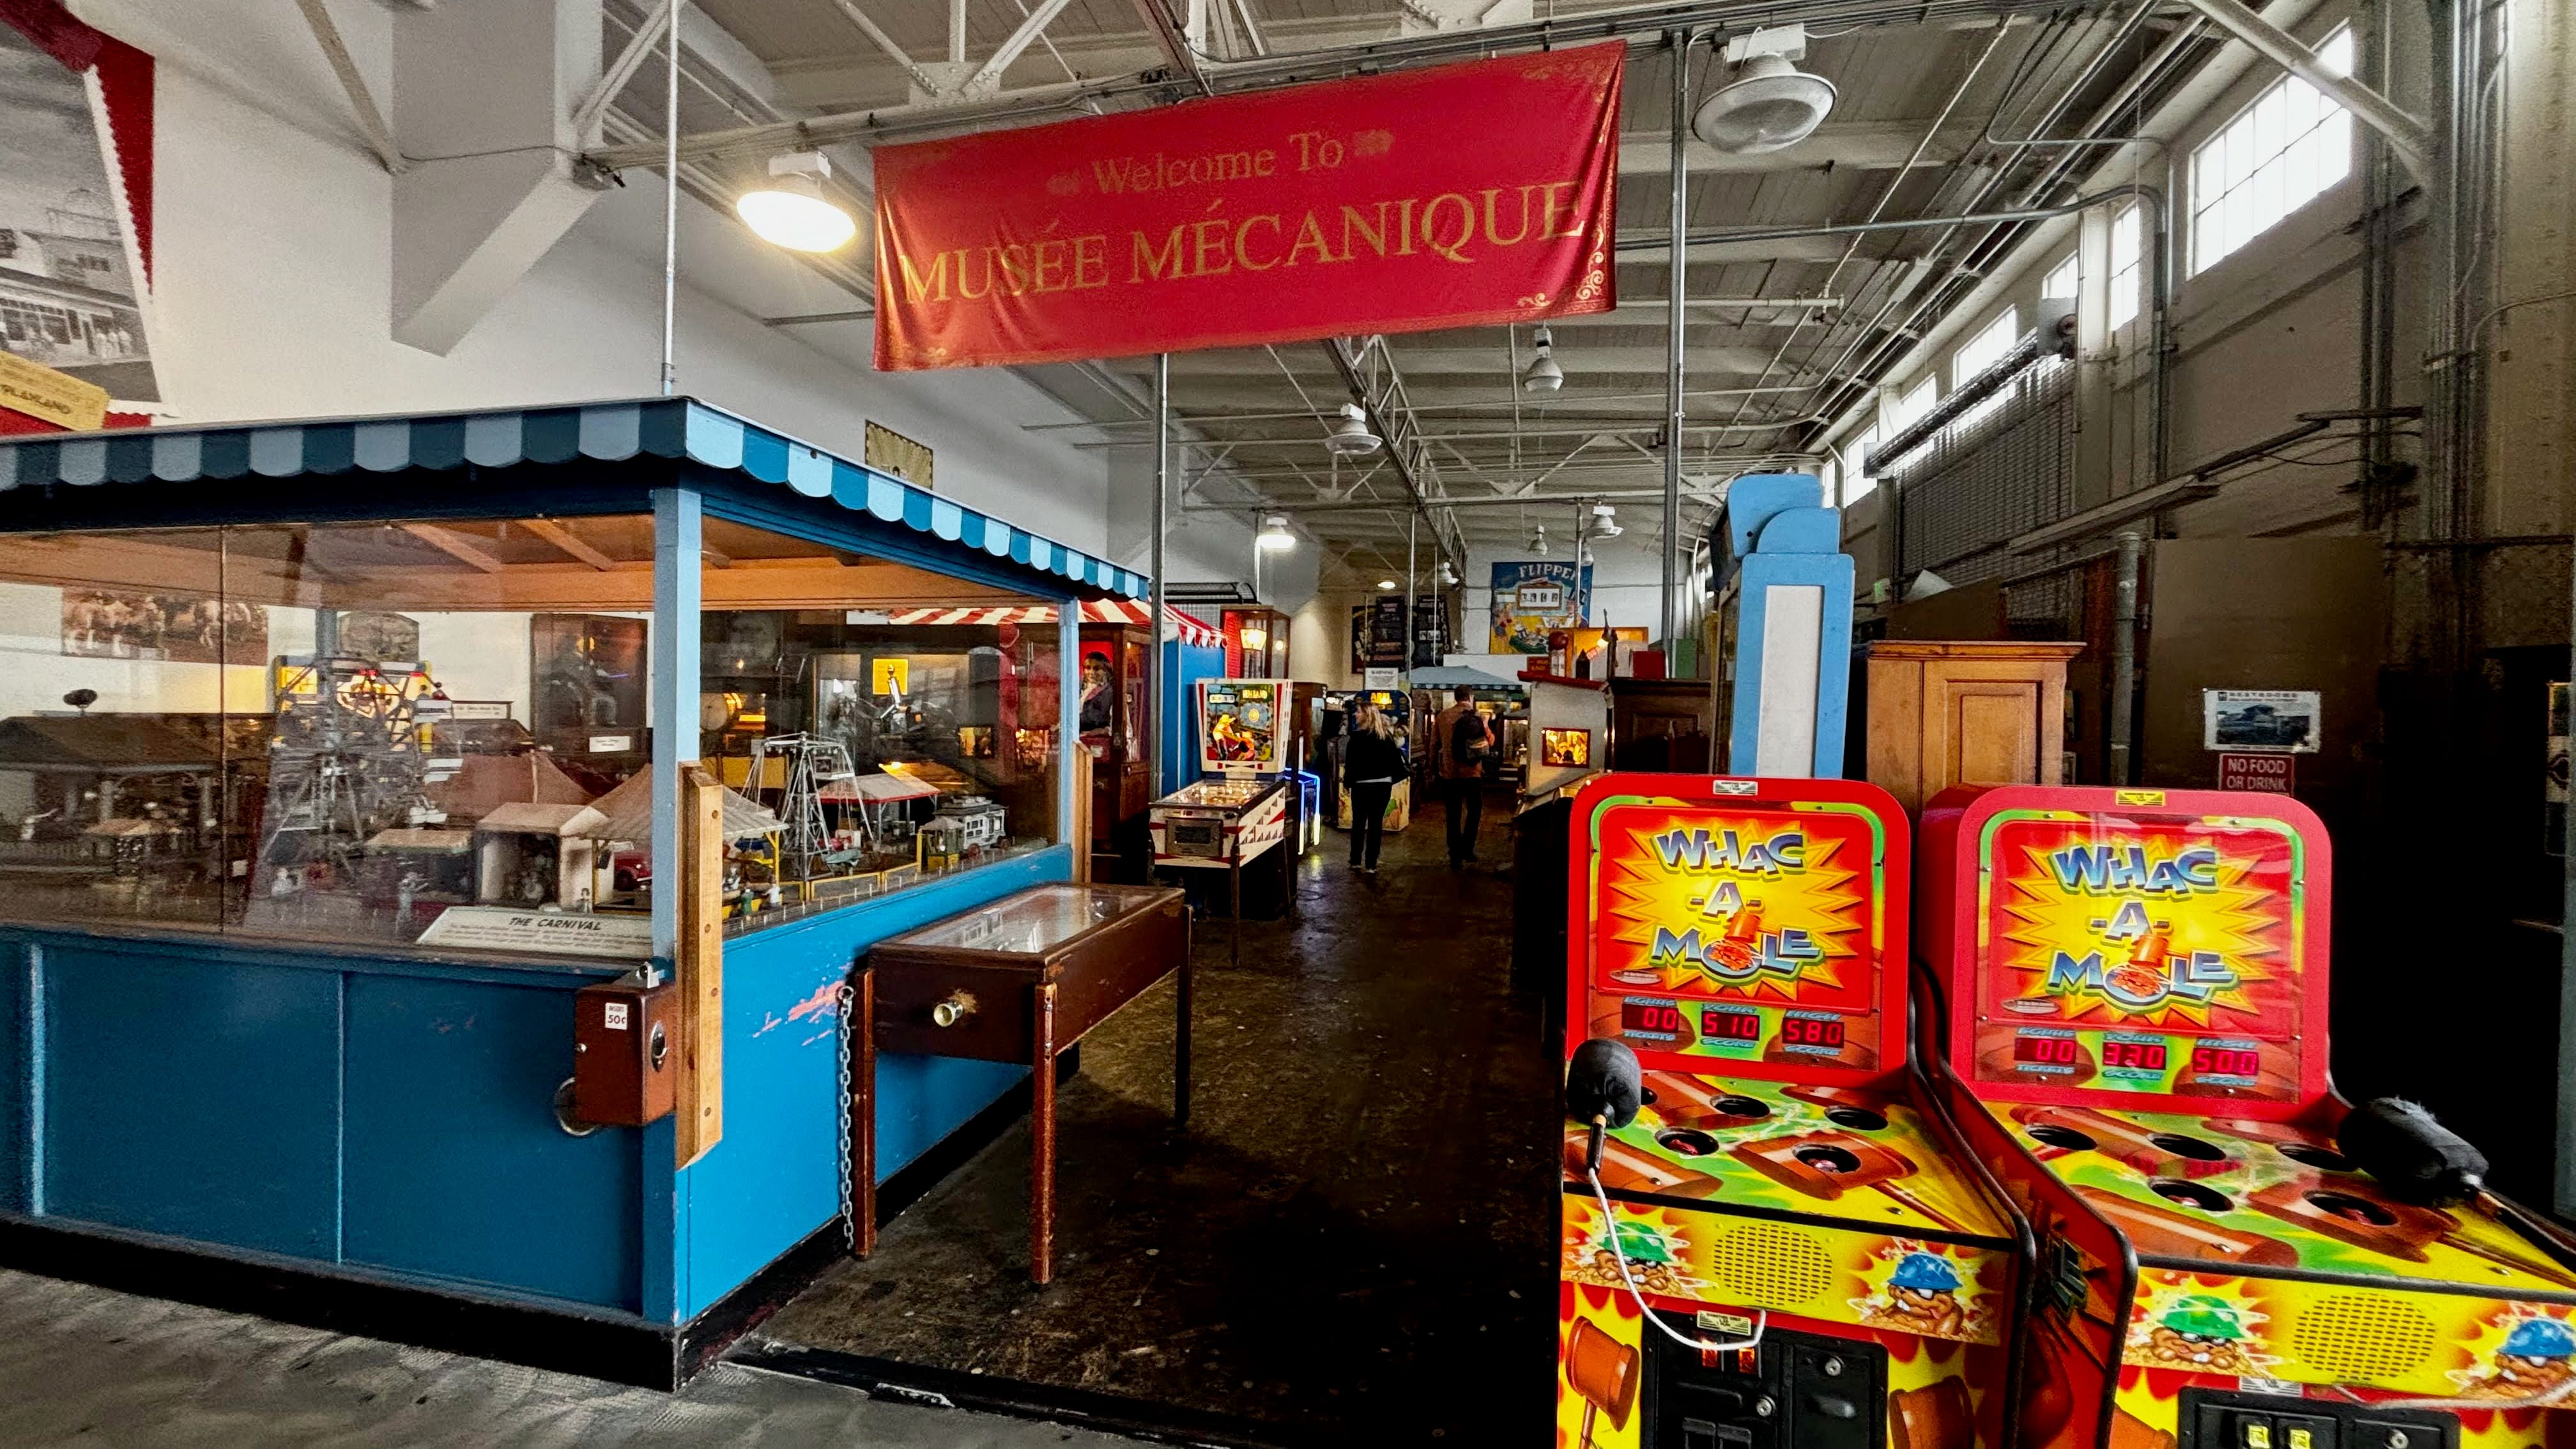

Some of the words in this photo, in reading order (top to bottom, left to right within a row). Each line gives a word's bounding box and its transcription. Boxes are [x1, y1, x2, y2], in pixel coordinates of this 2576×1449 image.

[1091, 148, 1277, 194] Welcome
[1289, 130, 1344, 172] To
[898, 218, 1110, 305] MUSÉE
[1127, 180, 1586, 284] MÉCANIQUE
[2227, 758, 2248, 773] NO
[2250, 759, 2287, 774] FOOD
[2226, 775, 2245, 790] OR
[2247, 776, 2287, 791] DRINK
[1653, 827, 1805, 876] WHAC
[2052, 843, 2217, 896] WHAC
[509, 917, 533, 926] THE
[537, 918, 602, 931] CARNIVAL
[1650, 925, 1821, 977] MOLE
[2047, 949, 2236, 1006] MOLE
[1643, 1008, 1678, 1029] 00
[1701, 1003, 1757, 1014] YOUR
[1785, 1009, 1841, 1021] HIGH
[1624, 1029, 1677, 1041] TICKETS
[1704, 1013, 1758, 1037] 510
[1786, 1020, 1842, 1044] 580
[1701, 1038, 1756, 1048] SCORE
[2104, 1032, 2165, 1043] YOUR
[1784, 1045, 1841, 1055] SCORE
[2035, 1039, 2075, 1062] 00
[2103, 1043, 2165, 1069] 330
[2194, 1050, 2258, 1075] 500
[2102, 1069, 2164, 1080] SCORE
[2193, 1076, 2257, 1086] SCORE
